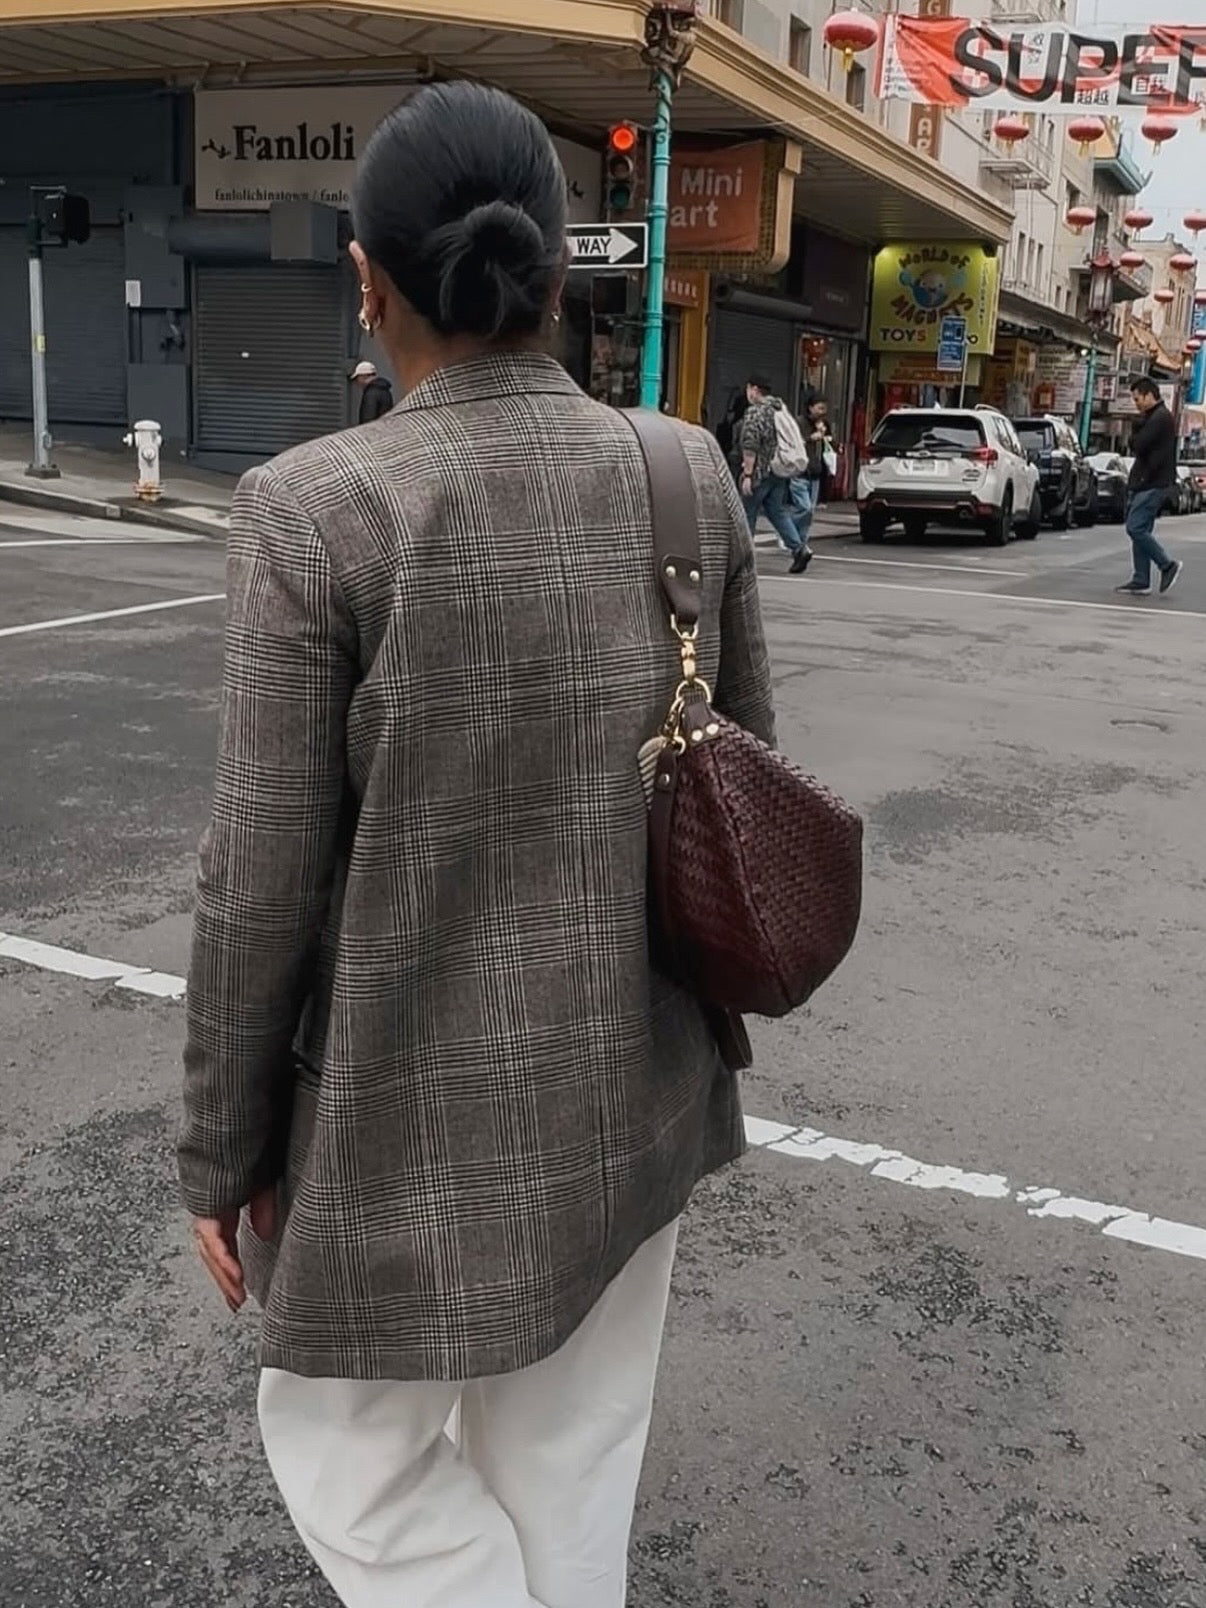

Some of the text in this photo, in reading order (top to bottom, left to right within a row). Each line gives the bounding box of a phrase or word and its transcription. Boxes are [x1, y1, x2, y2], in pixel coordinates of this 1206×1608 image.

[232, 122, 356, 161] Fanloli
[680, 167, 743, 197] Mini
[669, 202, 719, 228] art
[577, 237, 611, 254] WAY
[898, 247, 949, 268] WORLD
[880, 327, 927, 342] TOYS
